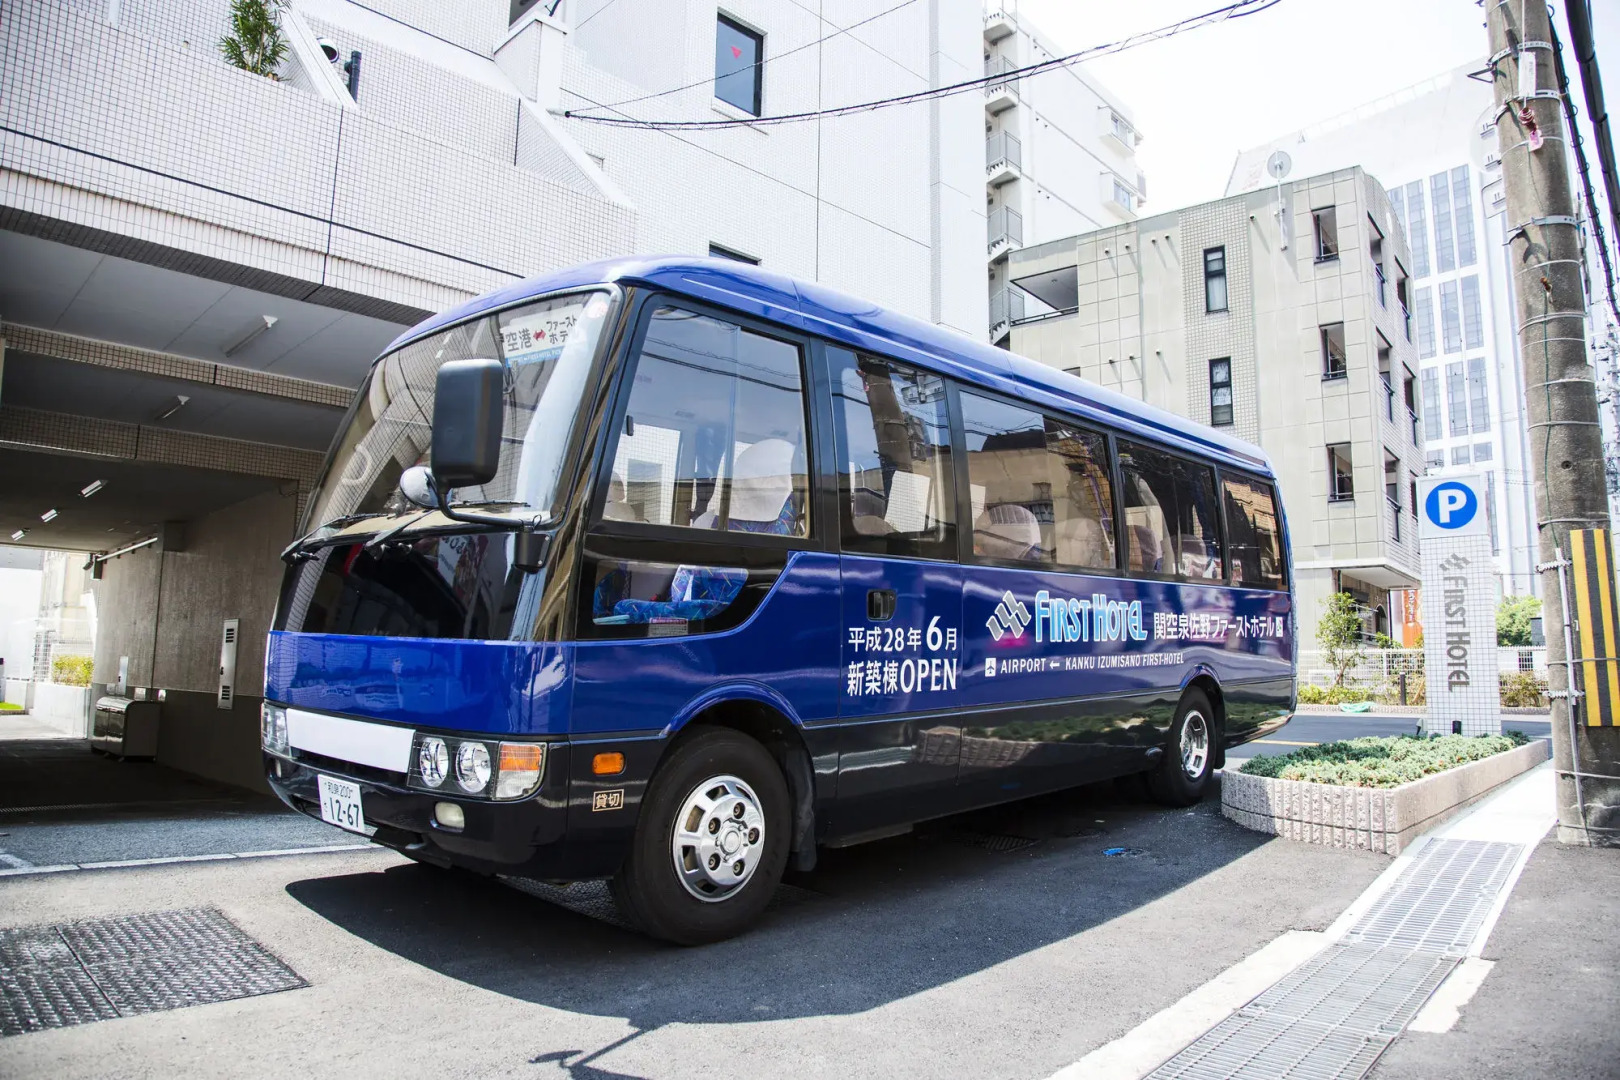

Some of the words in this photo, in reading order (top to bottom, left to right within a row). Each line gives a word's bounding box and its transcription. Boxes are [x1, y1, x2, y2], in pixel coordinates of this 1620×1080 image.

[546, 315, 577, 332] ファースト
[505, 328, 532, 352] 空港
[1437, 488, 1467, 524] P
[1034, 589, 1091, 643] FIRST
[1092, 593, 1149, 643] HOTEL
[1443, 575, 1468, 629] FIRST
[1153, 612, 1276, 640] 関空泉佐野ファーストホテル
[1000, 658, 1047, 674] AIRPORT
[1065, 656, 1095, 671] KANKU
[1097, 654, 1140, 669] IZUMISANO
[1142, 652, 1184, 666] FIRST-HOTEL
[1446, 631, 1471, 693] HOTEL
[595, 793, 620, 809] 貸切
